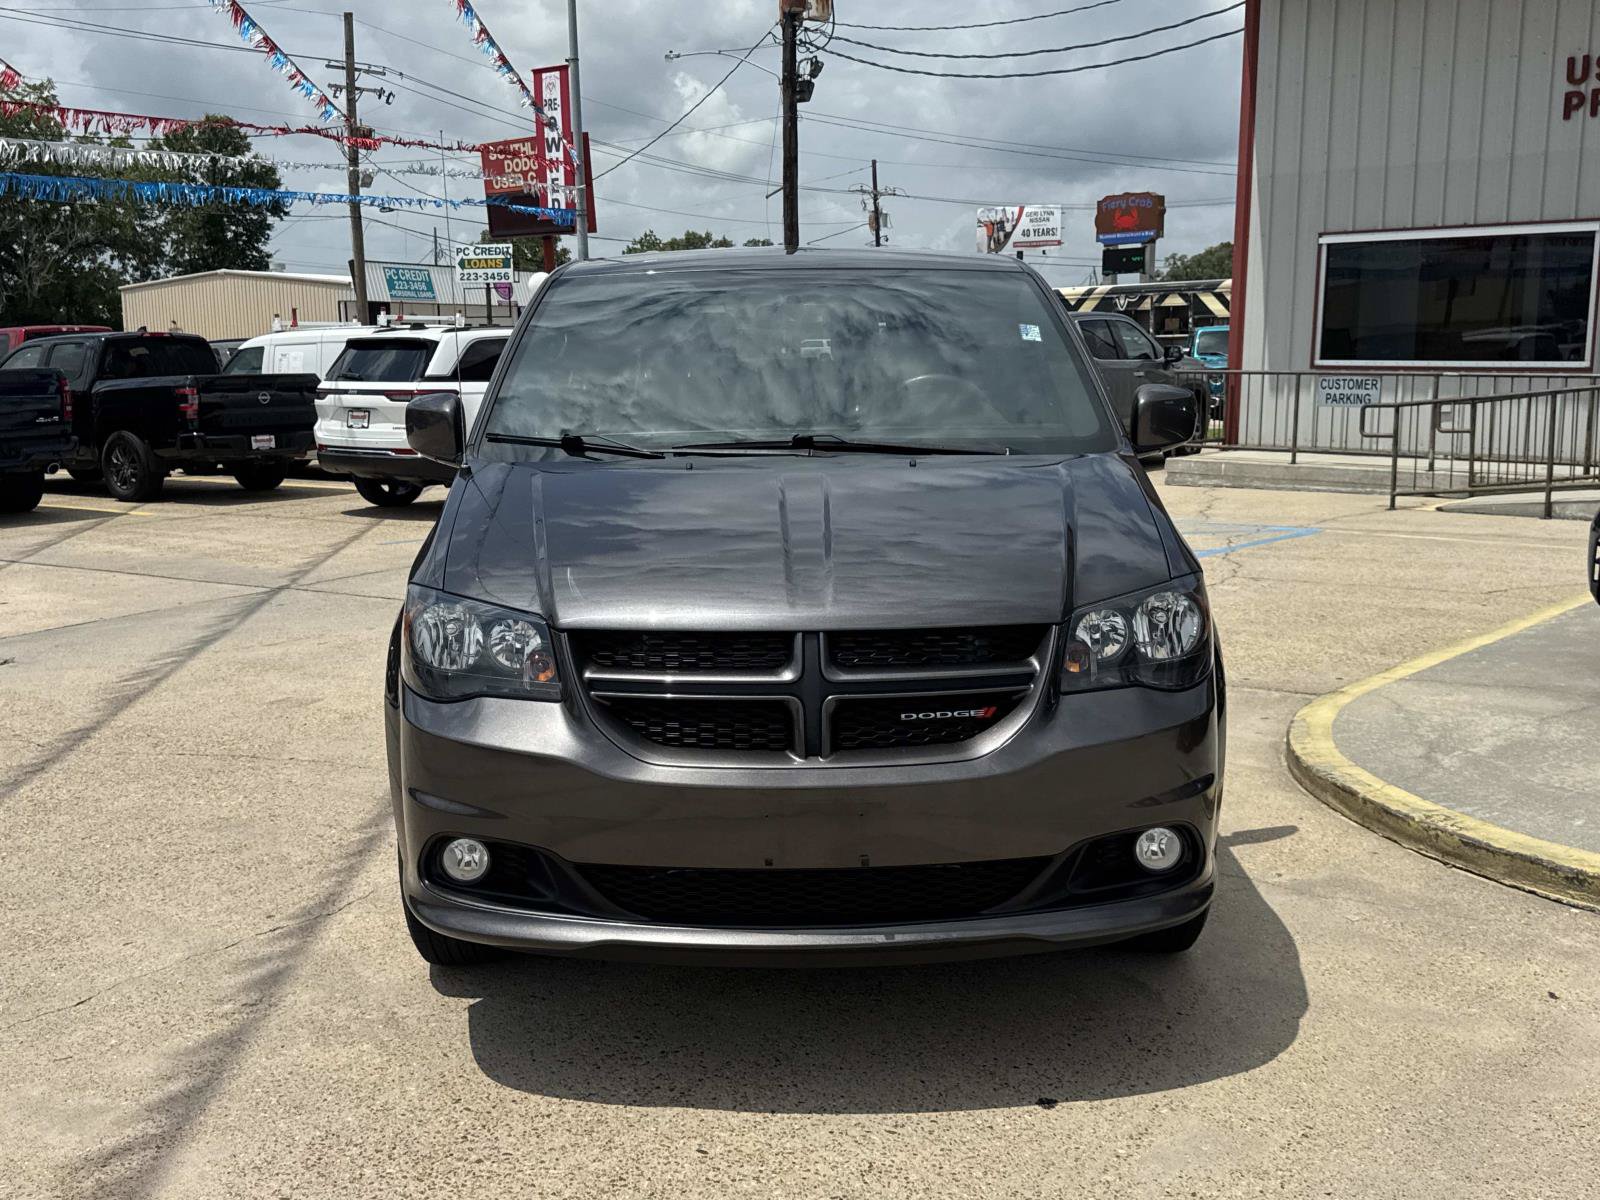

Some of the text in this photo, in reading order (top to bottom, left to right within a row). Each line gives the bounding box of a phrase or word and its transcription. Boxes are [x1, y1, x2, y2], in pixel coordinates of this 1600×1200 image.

[1567, 55, 1600, 85] U
[1021, 227, 1058, 238] 40 YEARS!
[456, 246, 511, 256] PC CREDIT
[464, 259, 504, 269] LOANS
[385, 268, 430, 282] PC CREDIT
[460, 272, 510, 281] 223-3456
[1321, 378, 1378, 390] CUSTOMER
[1325, 393, 1371, 405] PARKING
[901, 709, 985, 720] DODGE
